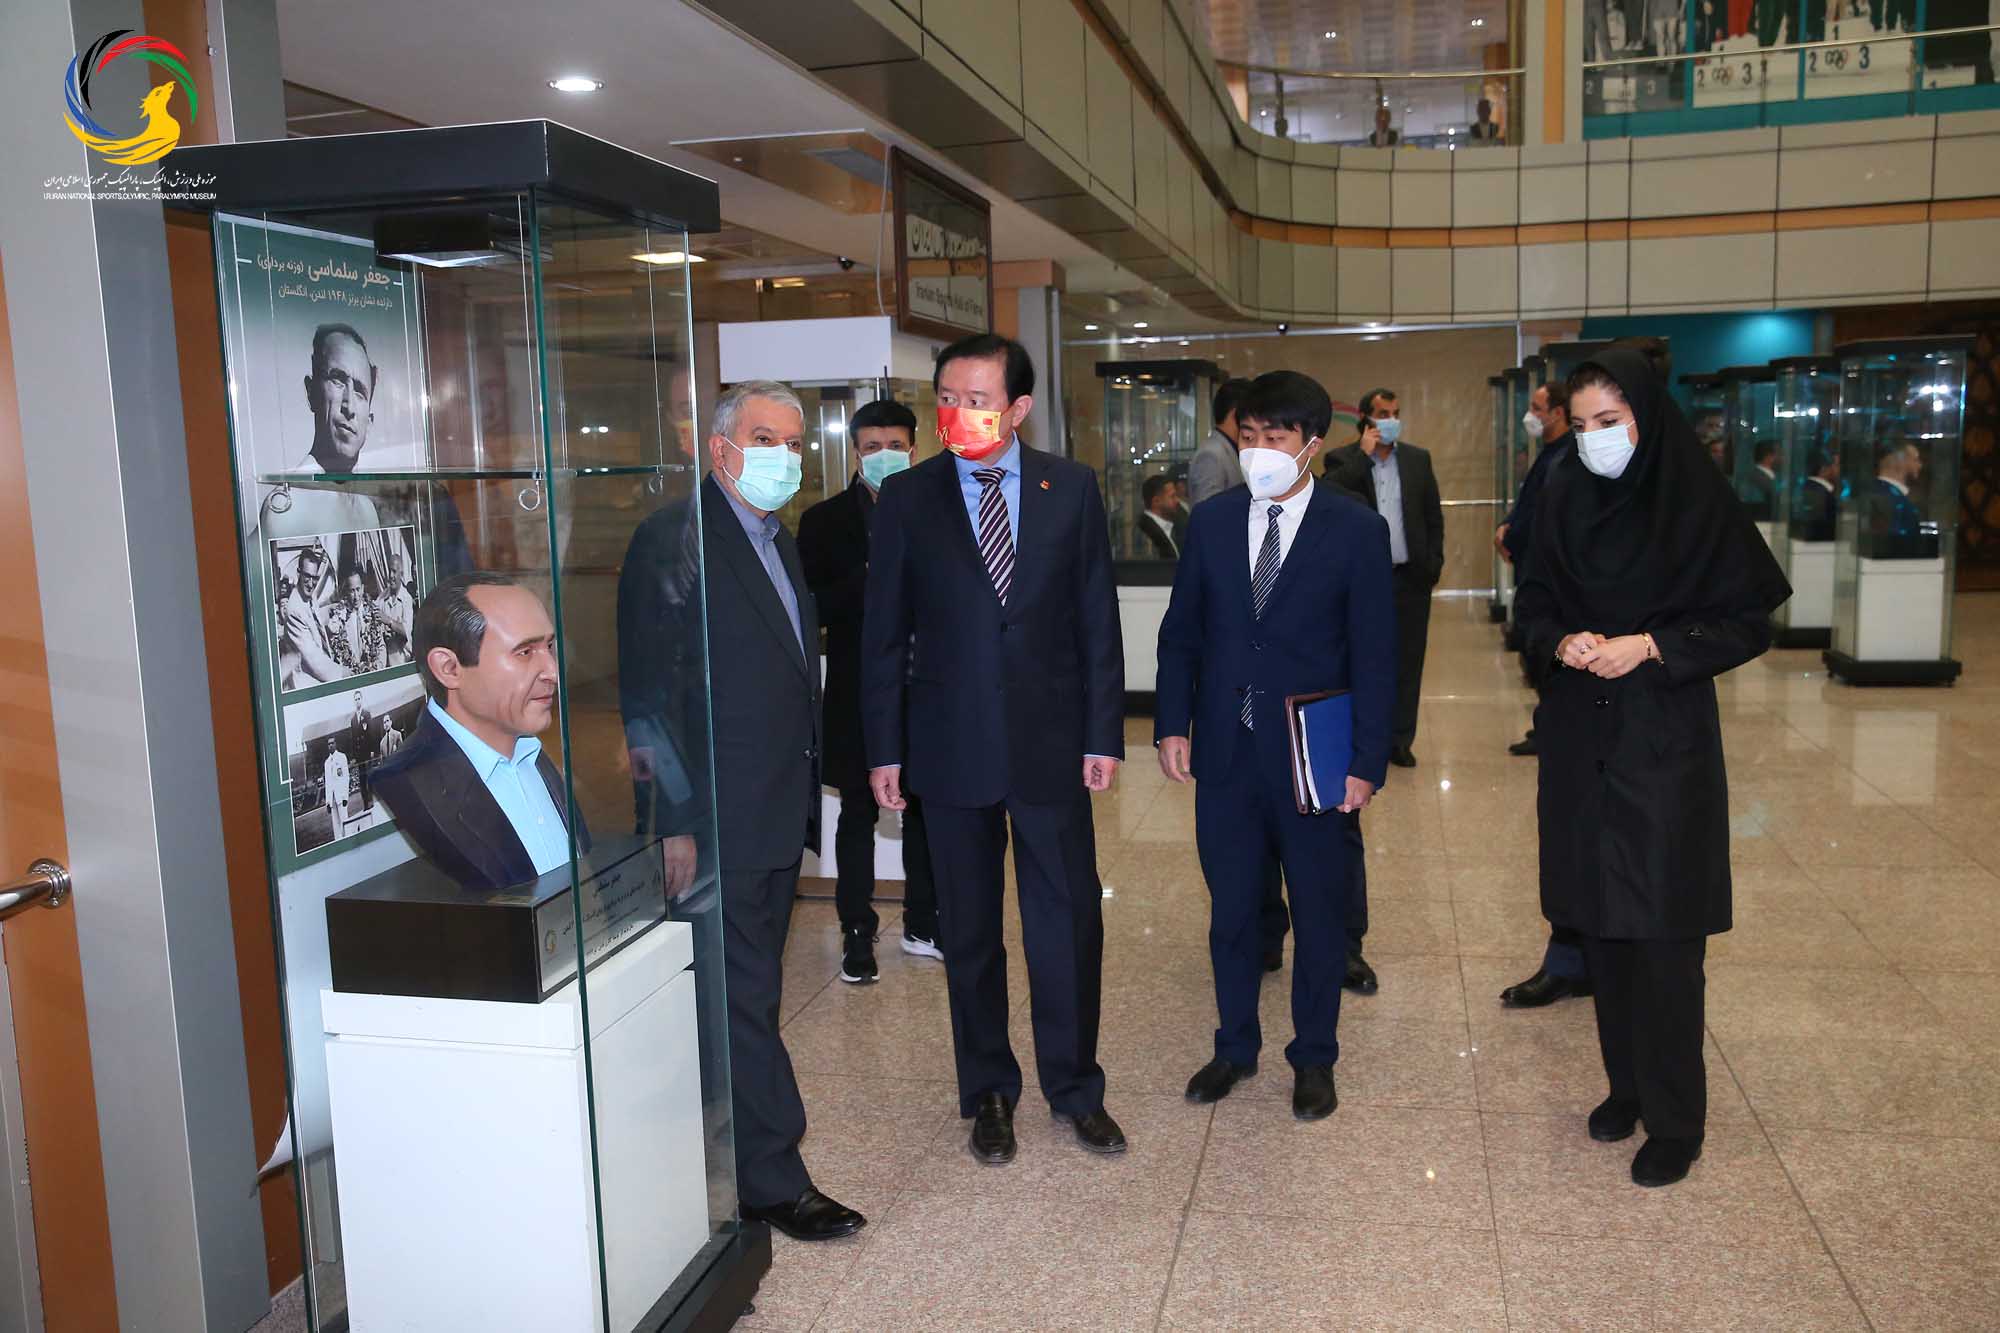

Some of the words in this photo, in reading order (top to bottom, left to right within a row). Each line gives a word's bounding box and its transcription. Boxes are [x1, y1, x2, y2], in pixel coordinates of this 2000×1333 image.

[1808, 51, 1818, 73] 2
[1858, 46, 1870, 70] 3
[1697, 68, 1705, 88] 2
[1742, 61, 1752, 86] 3
[308, 258, 358, 282] سلماسی
[362, 264, 391, 290] جعفر
